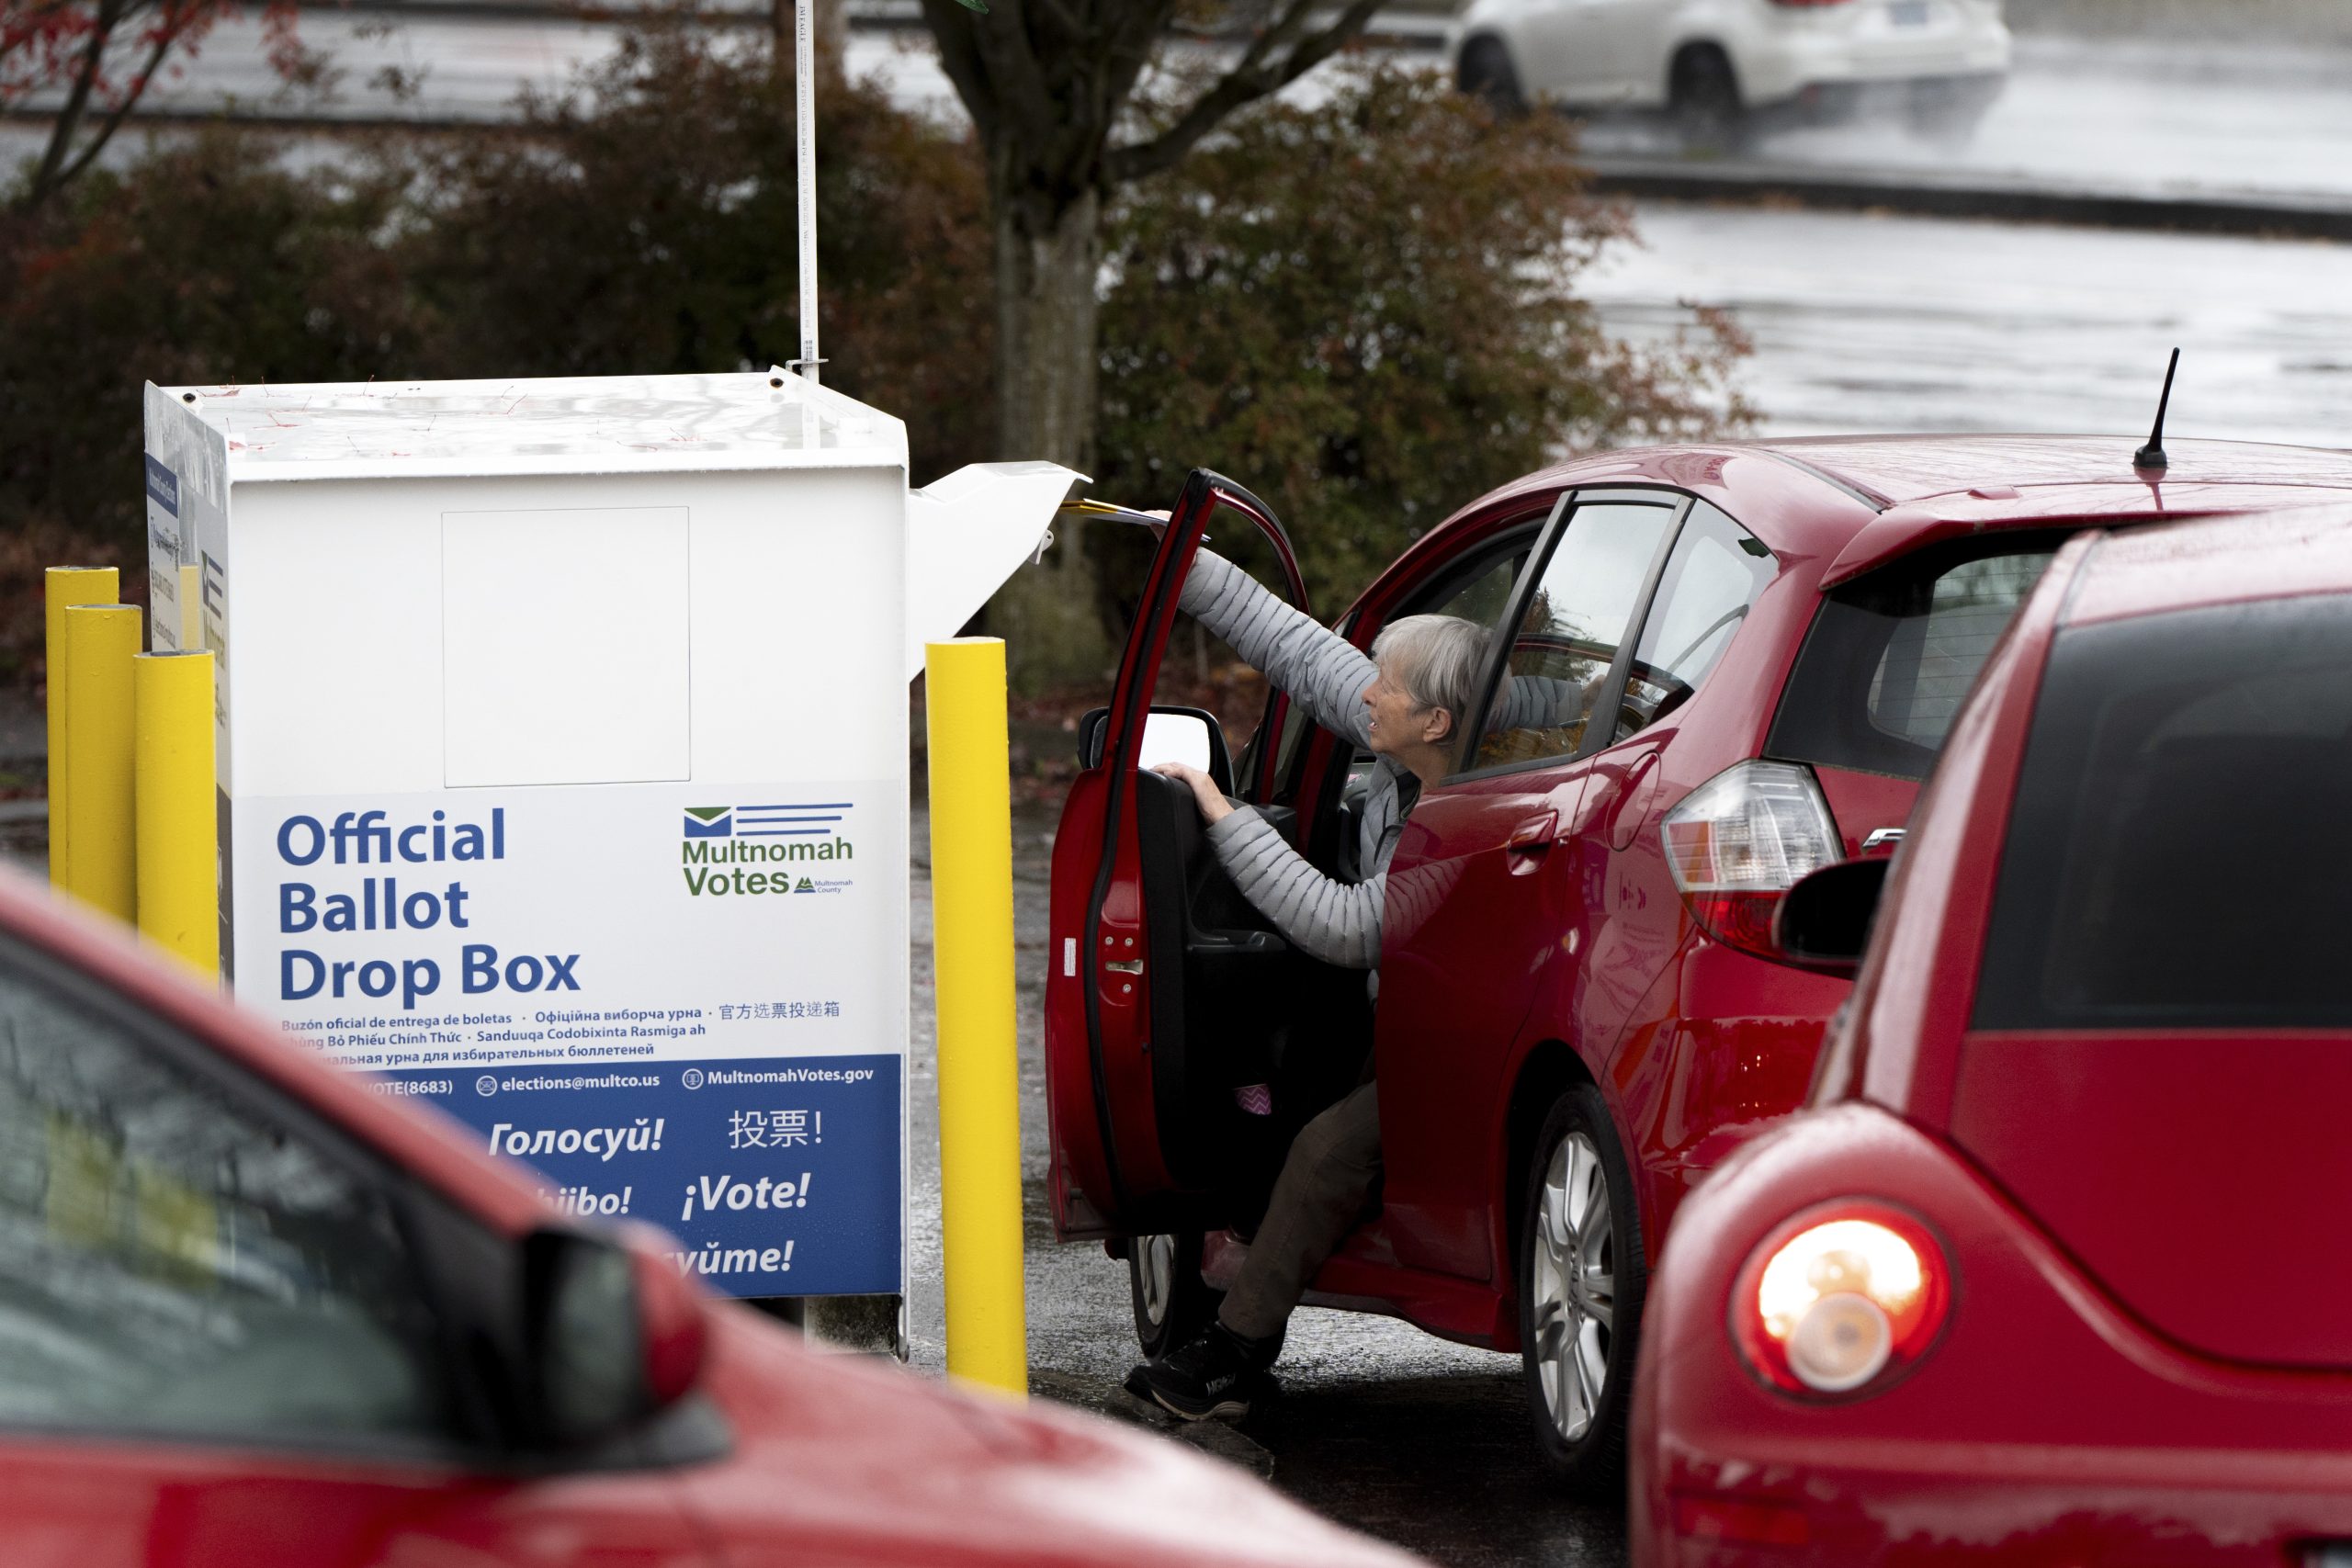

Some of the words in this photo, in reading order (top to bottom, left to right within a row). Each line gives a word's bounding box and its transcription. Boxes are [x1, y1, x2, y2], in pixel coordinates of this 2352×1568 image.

[277, 807, 504, 866] Official
[683, 837, 853, 864] Multnomah
[684, 866, 789, 896] Votes
[814, 879, 853, 887] Multnomah
[818, 886, 842, 895] County
[280, 877, 469, 933] Ballot
[280, 949, 441, 1010] Drop
[462, 944, 582, 994] Box
[535, 1010, 600, 1025] Офіційна
[604, 1009, 664, 1021] виборча
[668, 1009, 702, 1021] урна
[718, 1001, 840, 1020] 官方选票投递箱
[281, 1019, 322, 1031] Buzón
[326, 1017, 366, 1030] oficial
[369, 1017, 386, 1028] de
[389, 1016, 440, 1029] entrega
[443, 1014, 459, 1025] de
[462, 1013, 512, 1025] boletas
[286, 1036, 324, 1050] hùng
[327, 1035, 345, 1047] Bỏ
[348, 1033, 386, 1046] Phiếu
[389, 1032, 427, 1044] Chính
[430, 1032, 462, 1043] Thức
[477, 1029, 544, 1043] Sanduuqa
[547, 1027, 628, 1040] Codobixinta
[630, 1025, 686, 1039] Rasmiga
[689, 1024, 706, 1035] ah
[386, 1054, 419, 1066] урна
[423, 1052, 449, 1064] для
[453, 1048, 564, 1063] избирательных
[568, 1043, 654, 1057] бюллетеней
[502, 1074, 661, 1091] elections@multco.us
[707, 1068, 874, 1084] MultnomahVotes.gov
[489, 1118, 665, 1161] Голосуй!
[729, 1109, 823, 1149] 投票!
[681, 1172, 811, 1221] ¡Vote!
